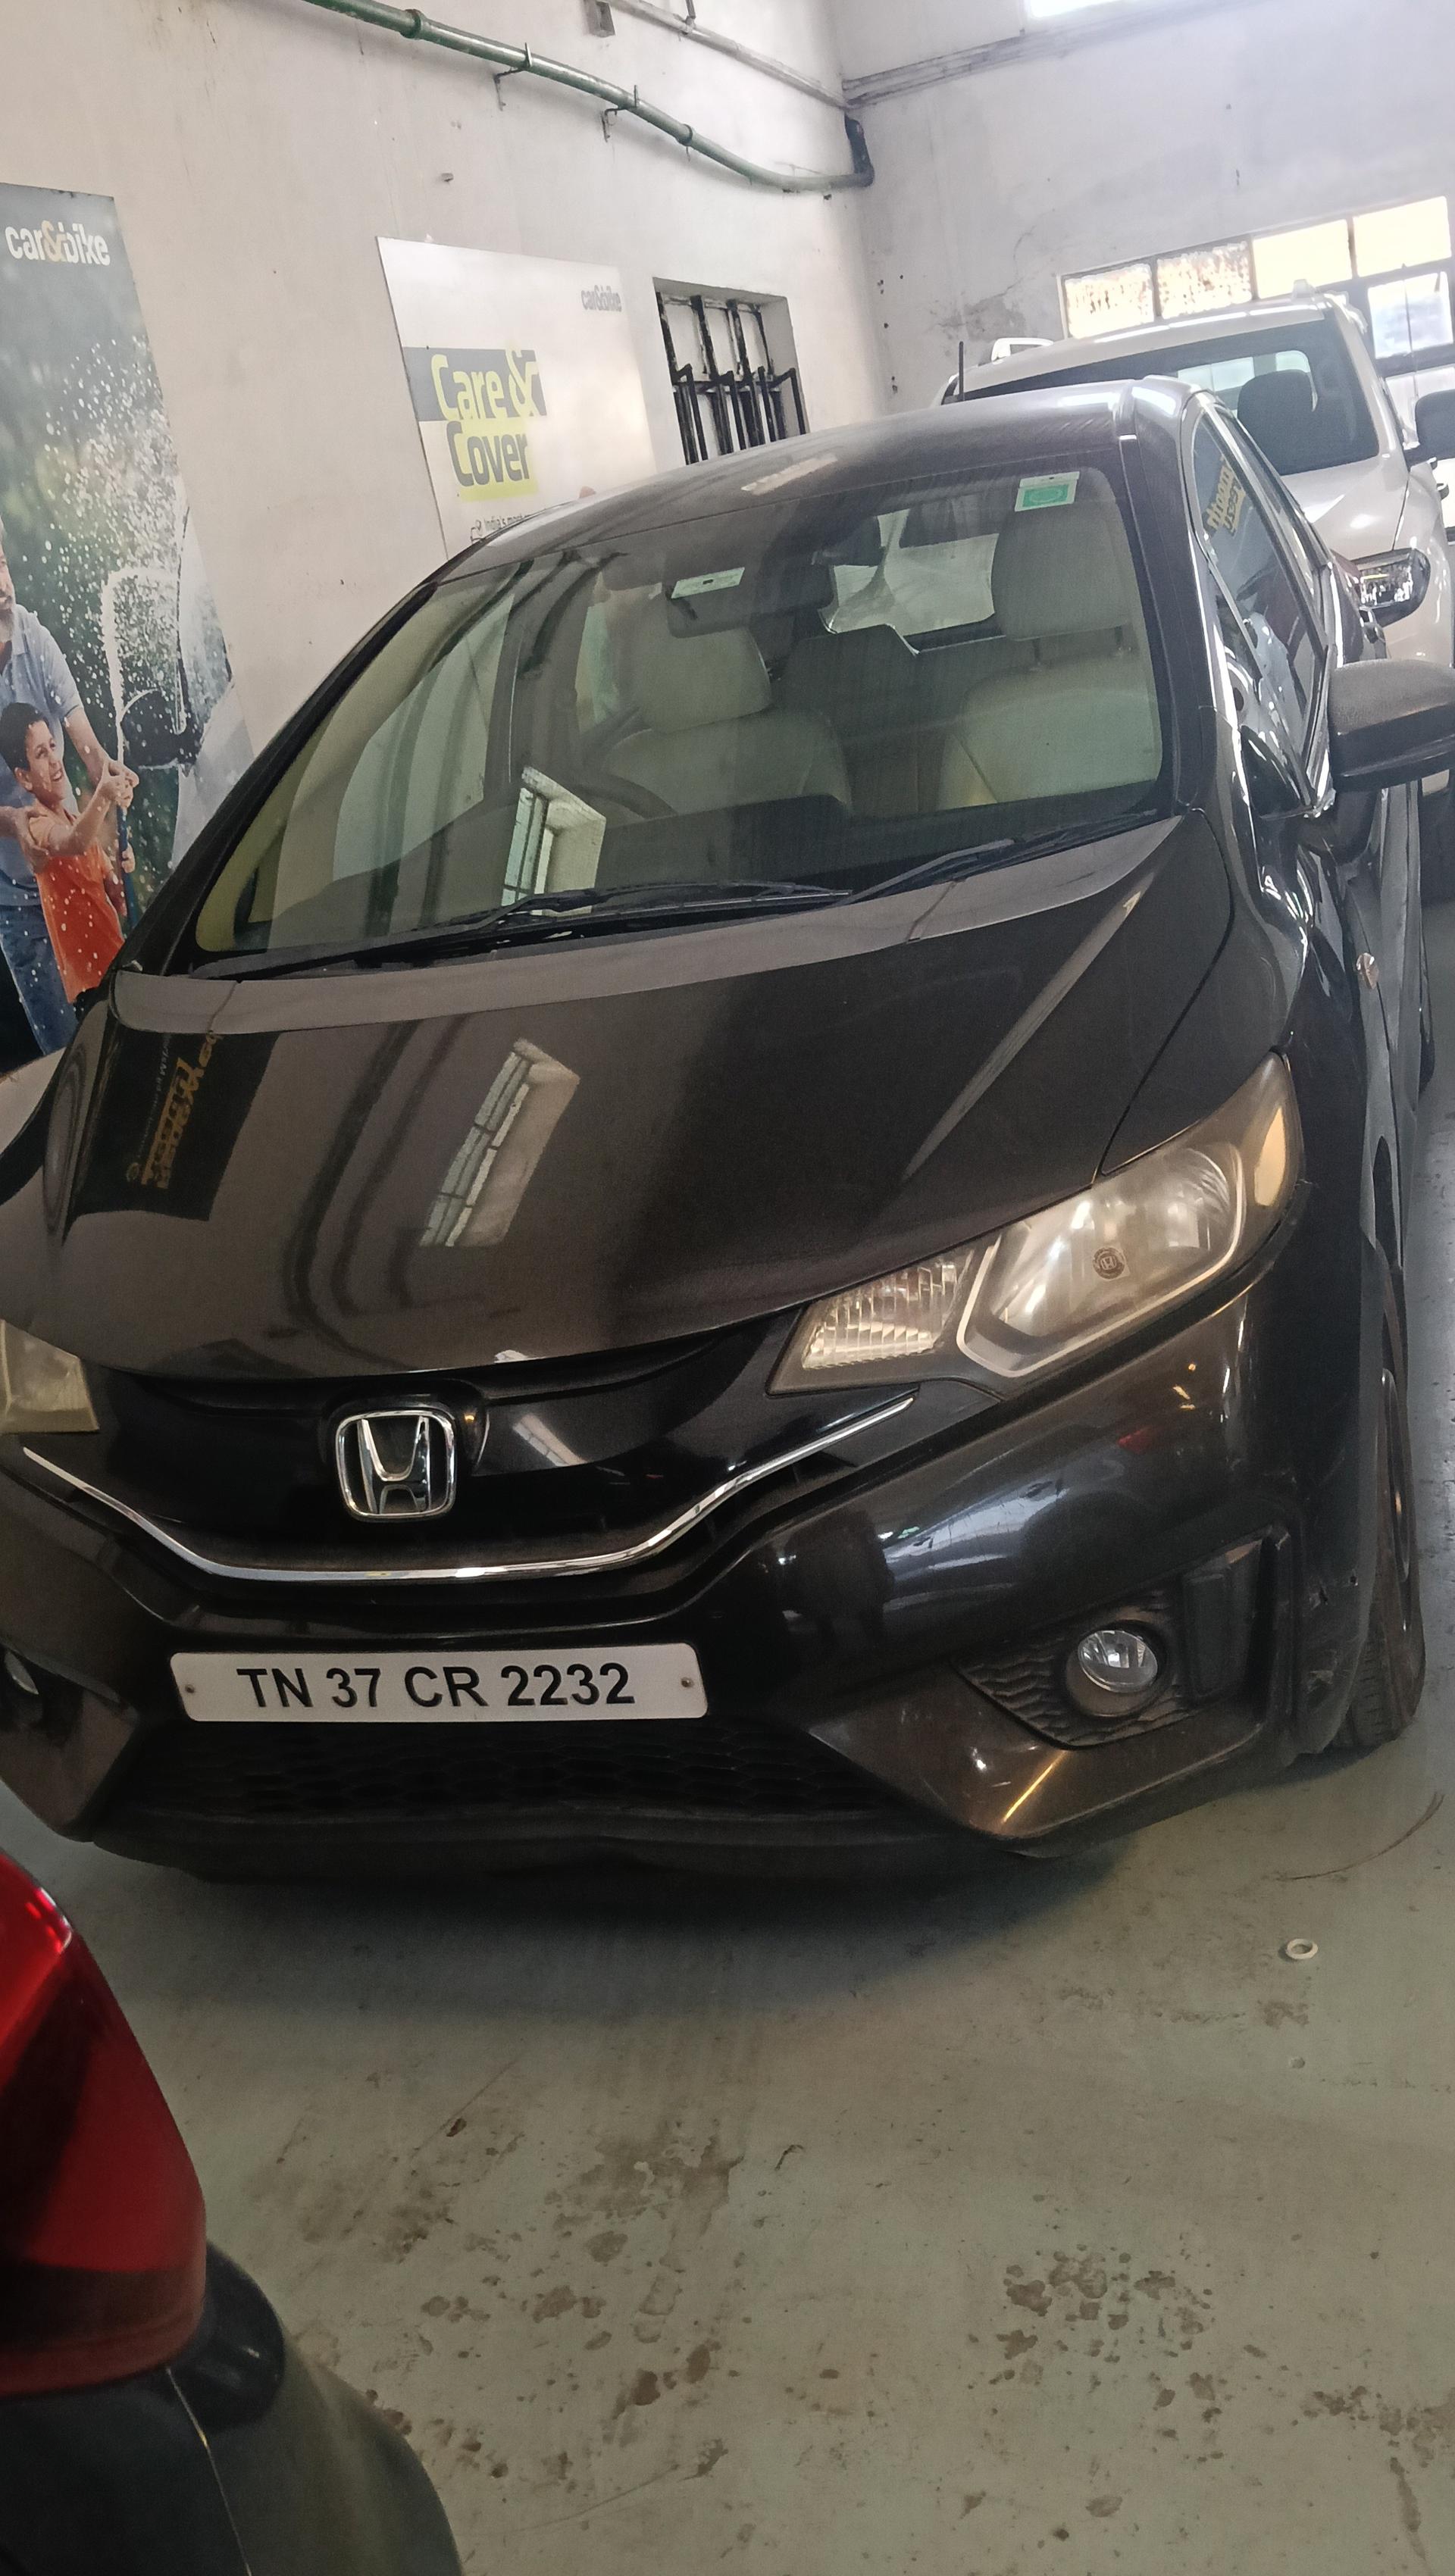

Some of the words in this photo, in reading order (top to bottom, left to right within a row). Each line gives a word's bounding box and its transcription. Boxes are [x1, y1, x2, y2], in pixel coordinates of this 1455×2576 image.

[5, 220, 111, 266] car&bike
[430, 353, 508, 421] Care
[505, 341, 540, 418] &
[446, 420, 530, 487] Cover
[236, 1667, 313, 1708] TN
[325, 1667, 382, 1708] 37
[404, 1666, 488, 1708] CR
[500, 1662, 635, 1707] 2232
